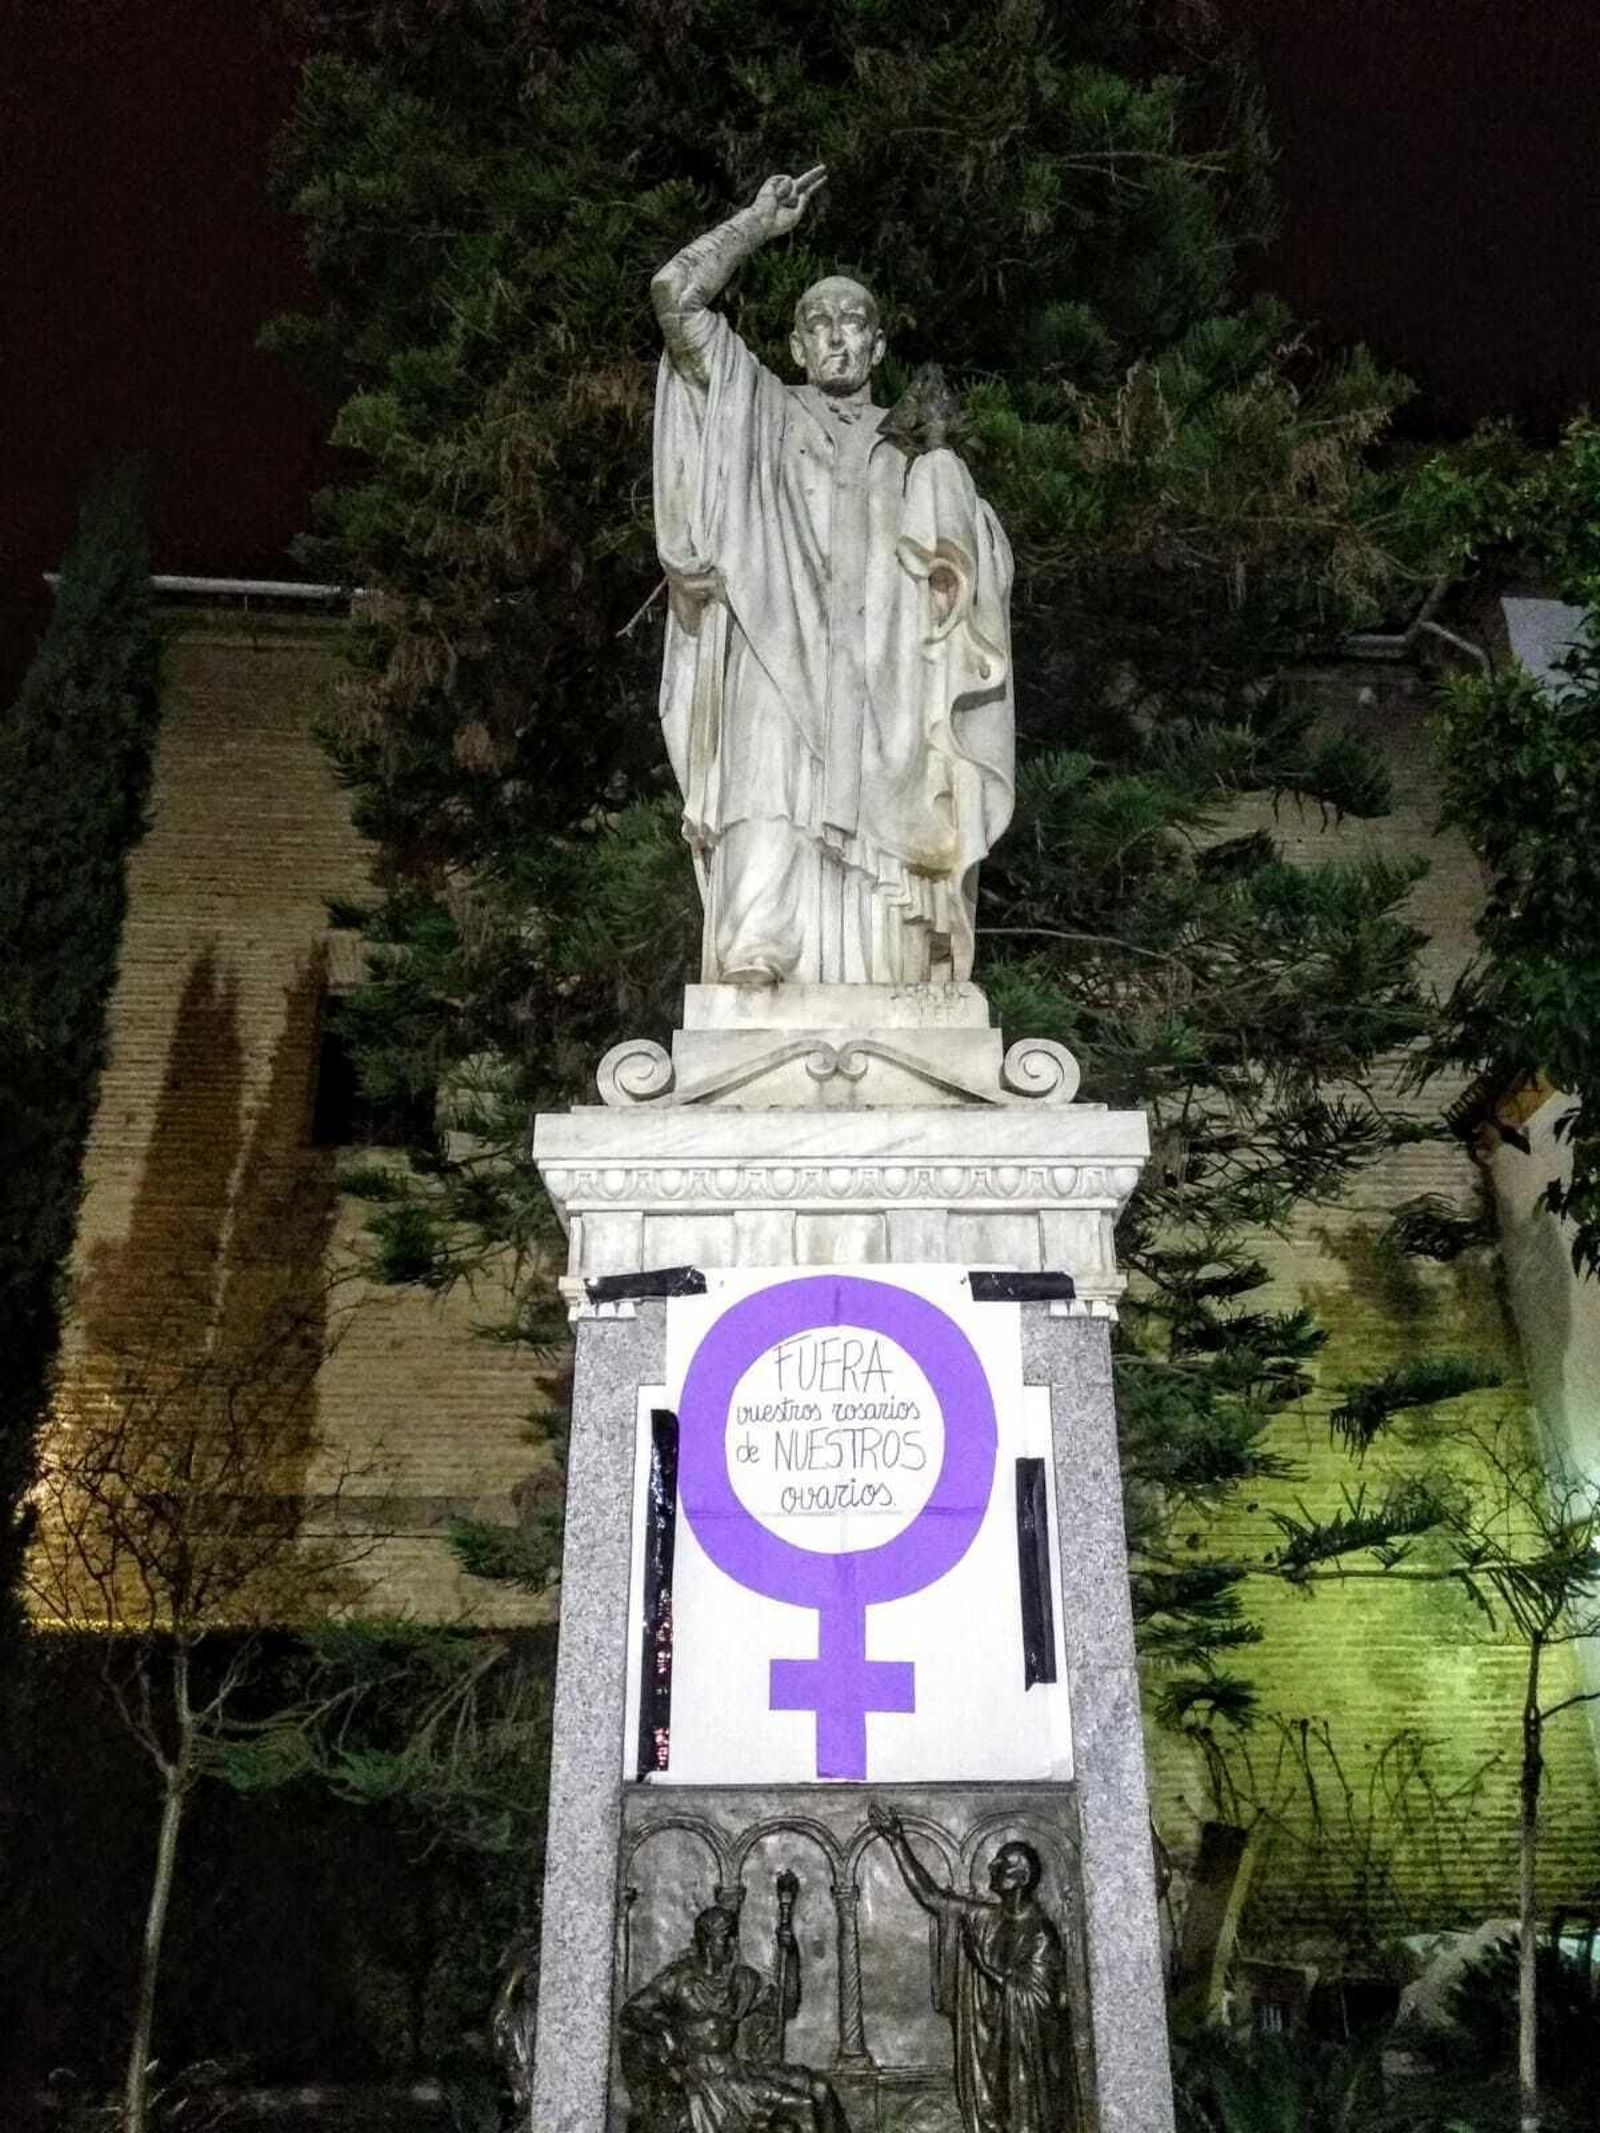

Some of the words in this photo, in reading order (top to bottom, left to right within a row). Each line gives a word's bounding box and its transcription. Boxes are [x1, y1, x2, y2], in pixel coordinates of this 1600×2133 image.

[773, 1334, 894, 1393] FUERA
[737, 1397, 822, 1425] vuestros
[832, 1395, 920, 1421] rosarios
[736, 1432, 760, 1463] de
[775, 1427, 927, 1471] NUESTROS
